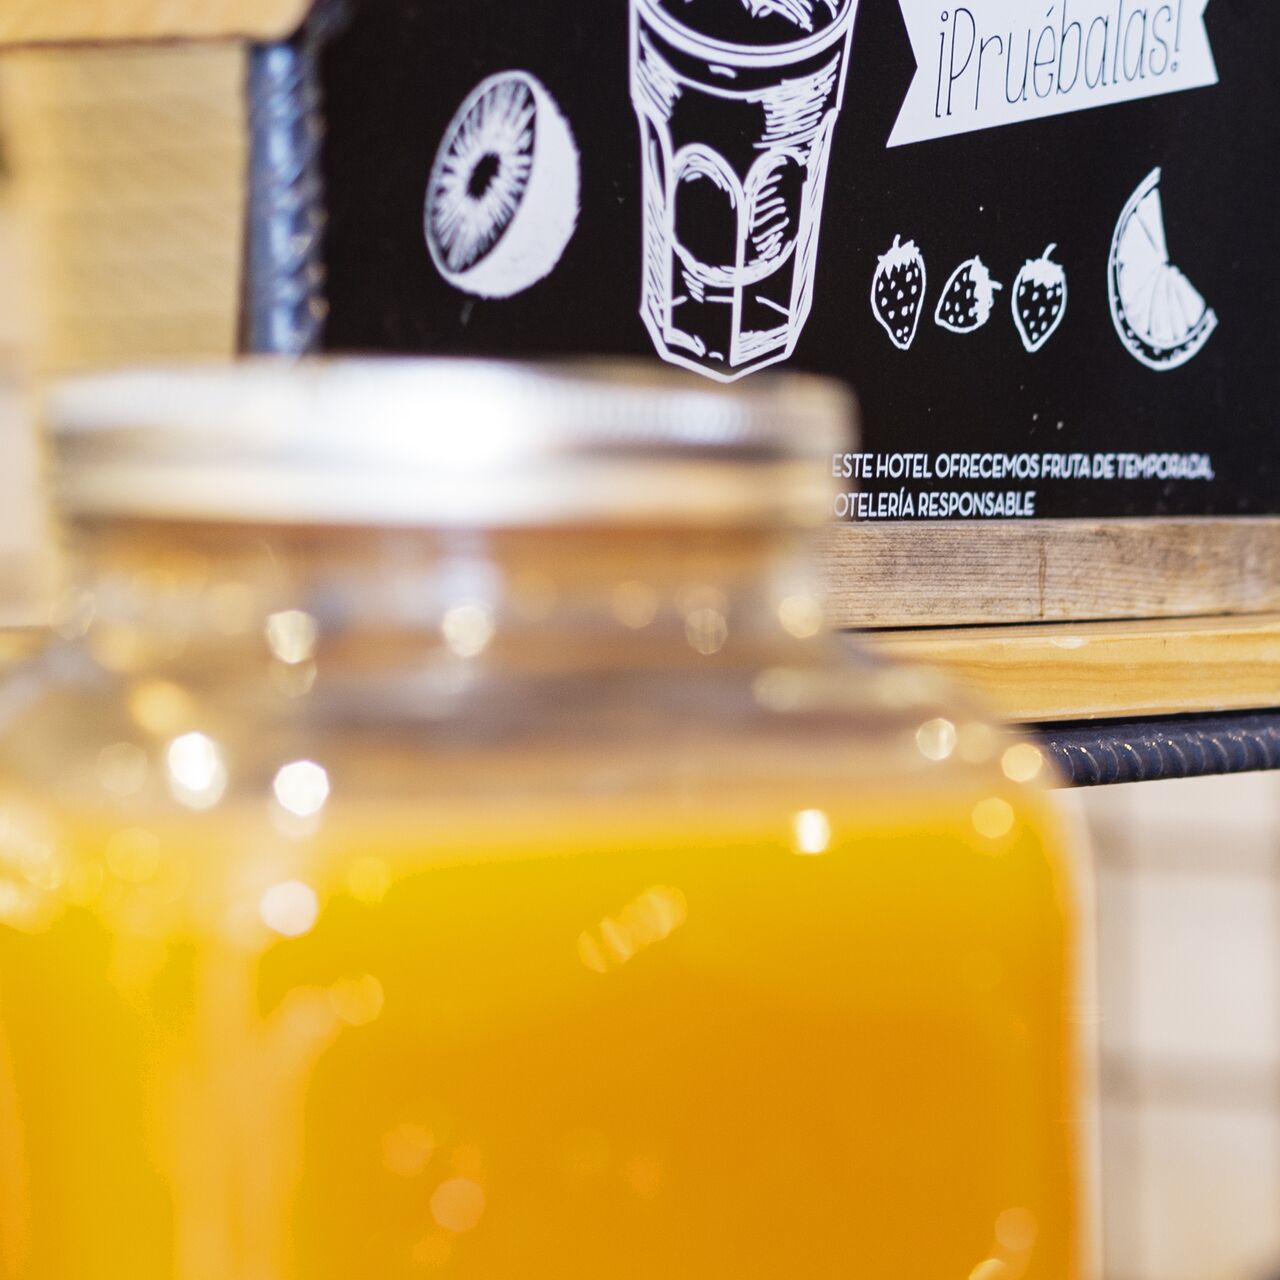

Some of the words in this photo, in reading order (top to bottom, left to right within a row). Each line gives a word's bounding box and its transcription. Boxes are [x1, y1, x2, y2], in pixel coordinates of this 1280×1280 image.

[935, 0, 1182, 118] ¡Pruébalas!
[832, 453, 873, 478] ESTE
[876, 453, 932, 478] HOTEL
[935, 453, 1040, 478] OFRECEMOS
[1041, 453, 1091, 479] FRUTA
[1093, 453, 1115, 479] DE
[833, 486, 914, 517] OTELERÍA
[918, 490, 1036, 518] RESPONSABLE
